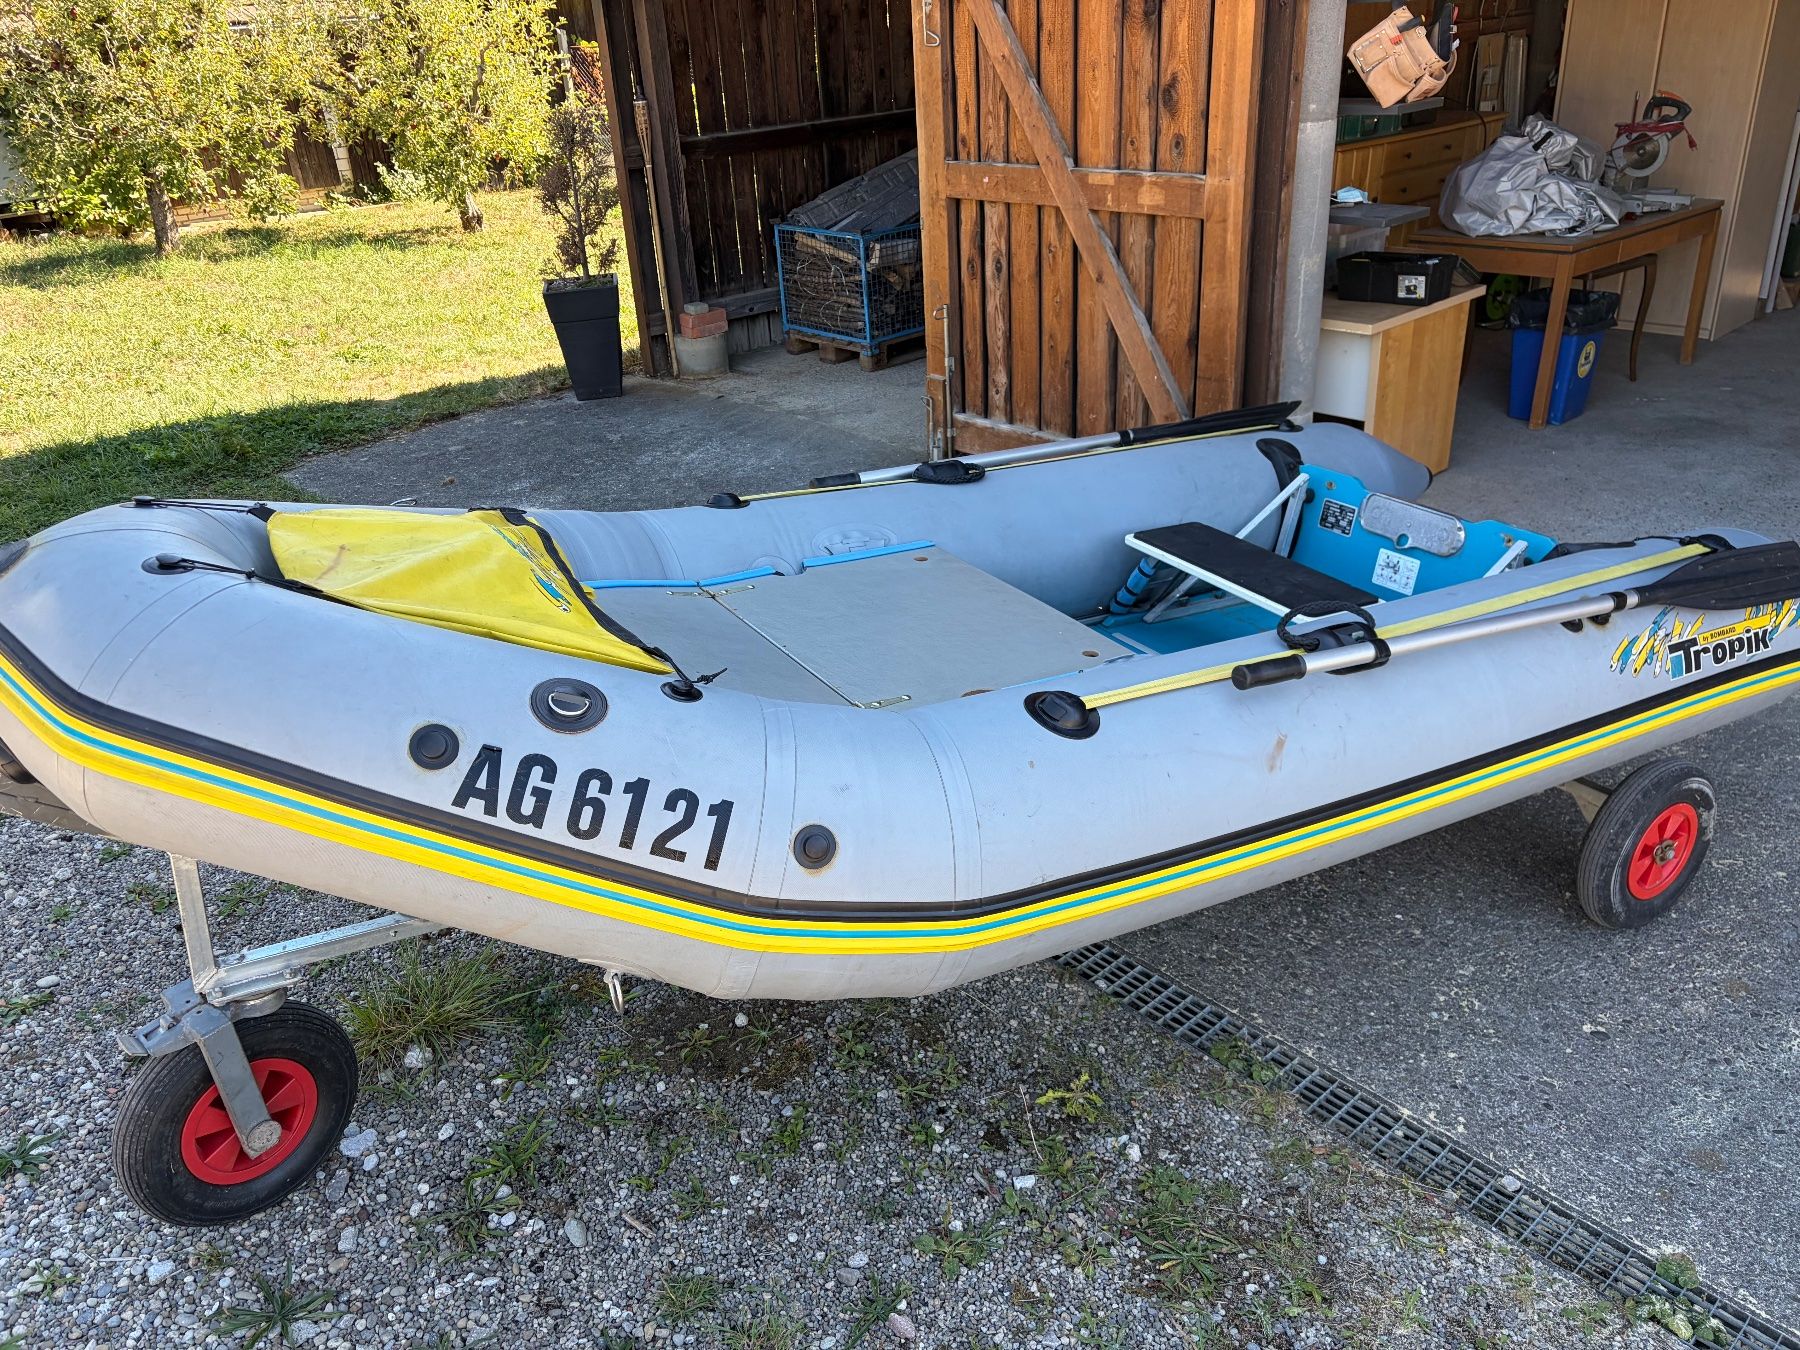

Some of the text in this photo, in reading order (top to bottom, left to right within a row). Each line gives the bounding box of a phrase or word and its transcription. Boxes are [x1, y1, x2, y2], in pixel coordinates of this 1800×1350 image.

[1667, 628, 1770, 675] Tropik
[1702, 626, 1737, 643] by BOMBARD
[451, 744, 735, 872] AG 6121
